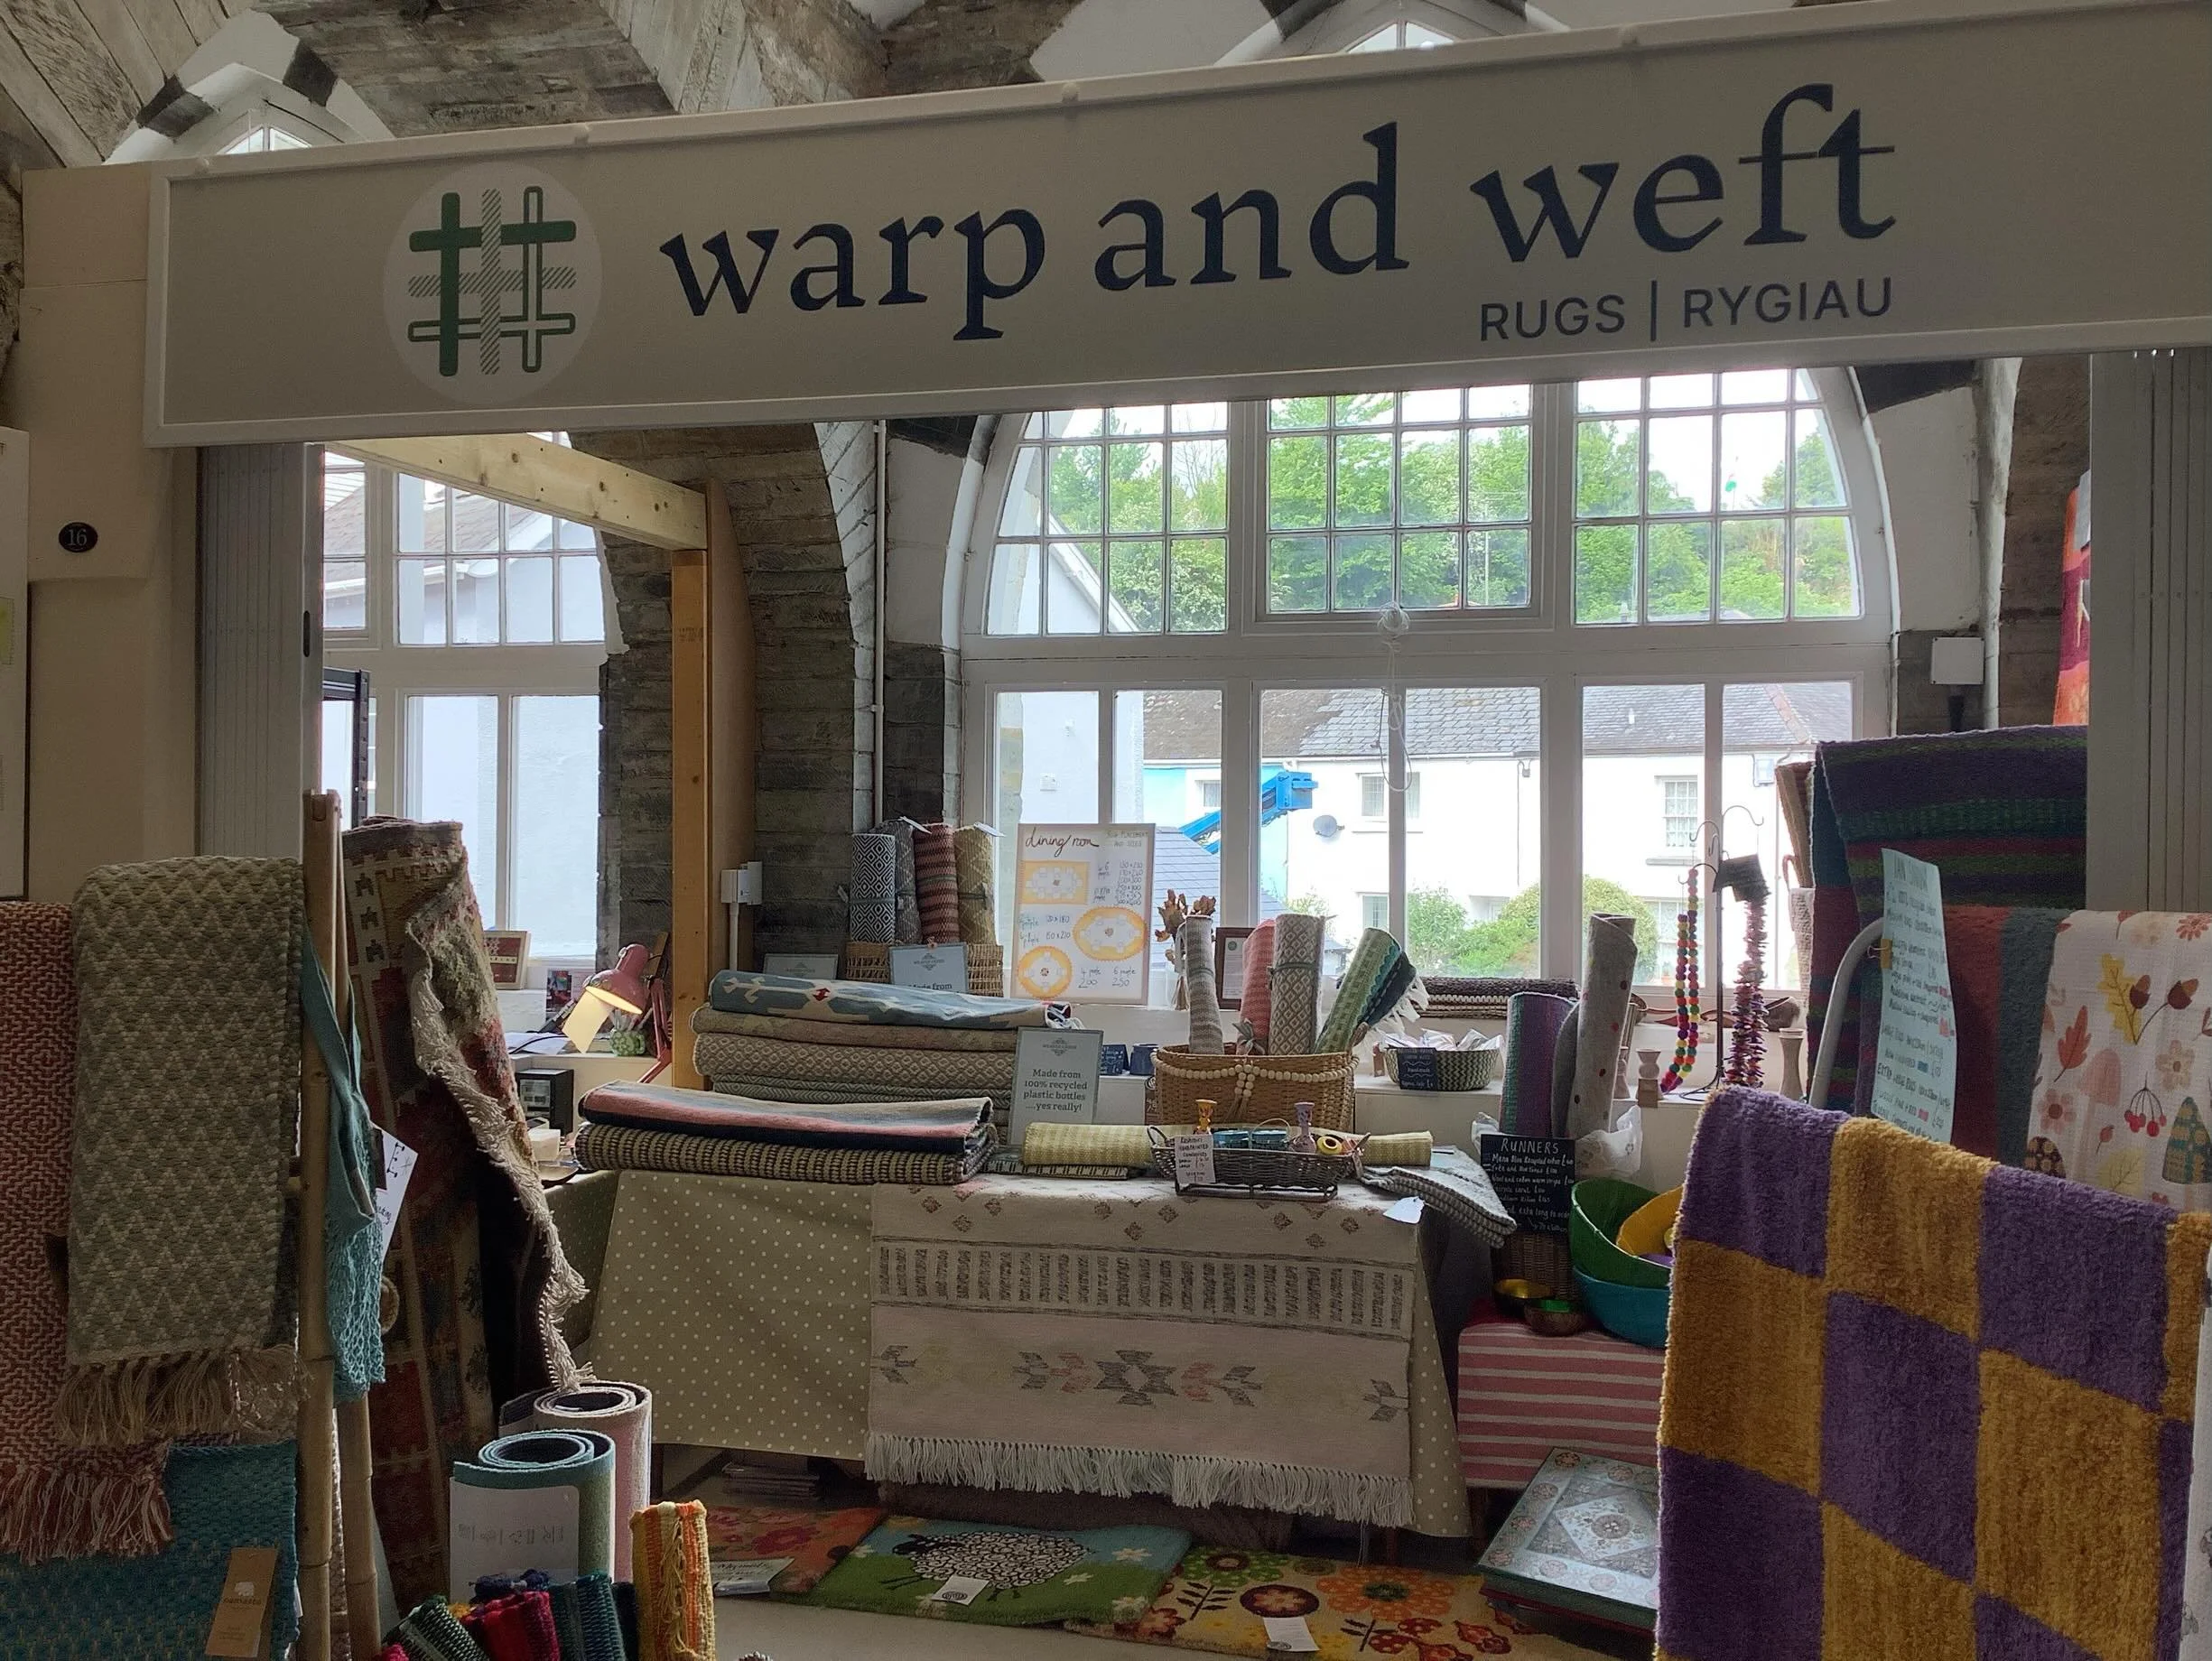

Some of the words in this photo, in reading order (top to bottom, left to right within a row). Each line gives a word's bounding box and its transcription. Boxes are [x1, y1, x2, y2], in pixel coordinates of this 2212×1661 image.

[658, 208, 1046, 342] warp
[1093, 122, 1410, 292] and
[1469, 82, 1897, 263] weft
[1479, 293, 1626, 342] RUGS
[1683, 276, 1892, 329] RYGIAU
[67, 529, 88, 546] 16
[1026, 826, 1072, 857] dining
[932, 982, 952, 990] from
[1032, 1069, 1057, 1077] Made
[1058, 1070, 1082, 1079] from
[1024, 1080, 1048, 1089] 100%
[1048, 1081, 1088, 1090] recycled
[1023, 1090, 1054, 1100] plastic
[1055, 1091, 1086, 1100] bottles
[1053, 1102, 1082, 1112] really!
[1501, 1137, 1559, 1155] RUNNERS
